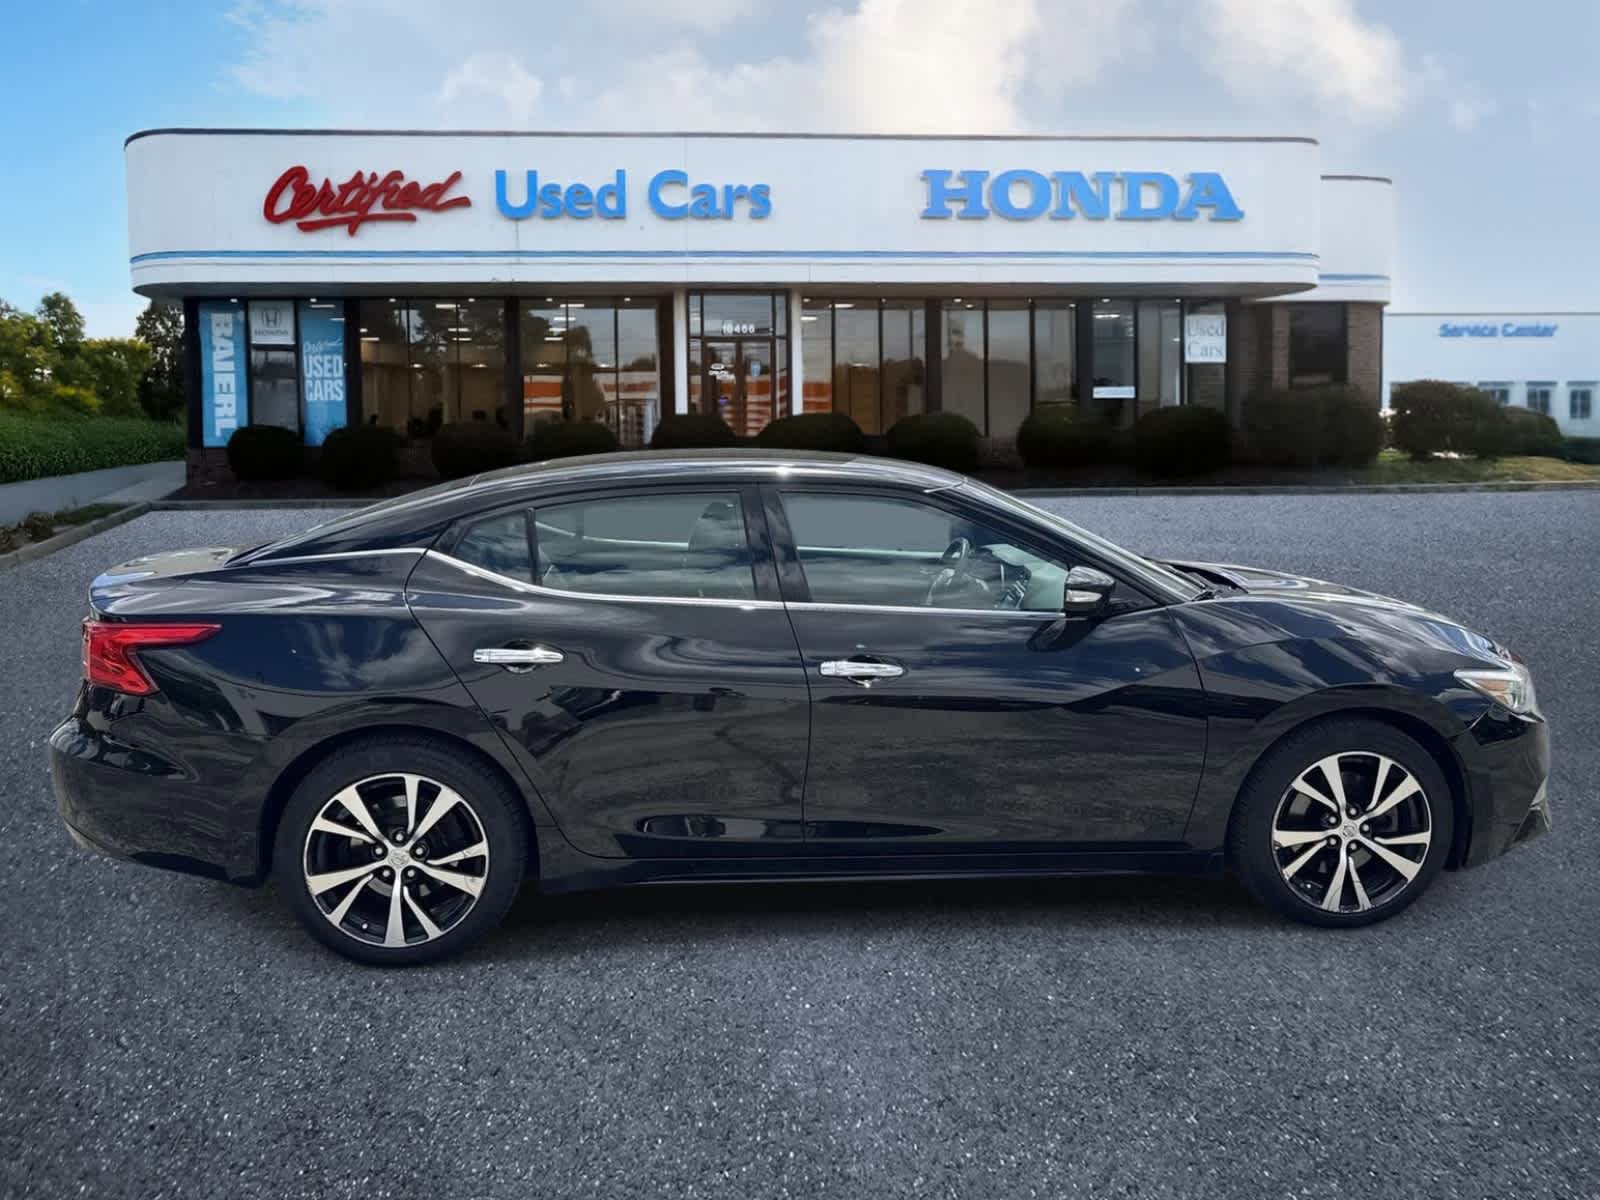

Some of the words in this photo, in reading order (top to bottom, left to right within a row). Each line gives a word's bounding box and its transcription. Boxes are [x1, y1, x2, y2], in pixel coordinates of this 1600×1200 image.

[264, 165, 471, 238] Certified
[495, 169, 627, 221] Used
[648, 169, 773, 221] Cars
[920, 169, 1245, 222] HONDA
[1187, 319, 1225, 337] Used
[1439, 323, 1498, 338] Service
[1502, 323, 1558, 338] Center
[1187, 341, 1225, 358] Cars
[210, 312, 237, 437] BAIERL
[303, 355, 342, 378] USED
[305, 378, 344, 402] CARS
